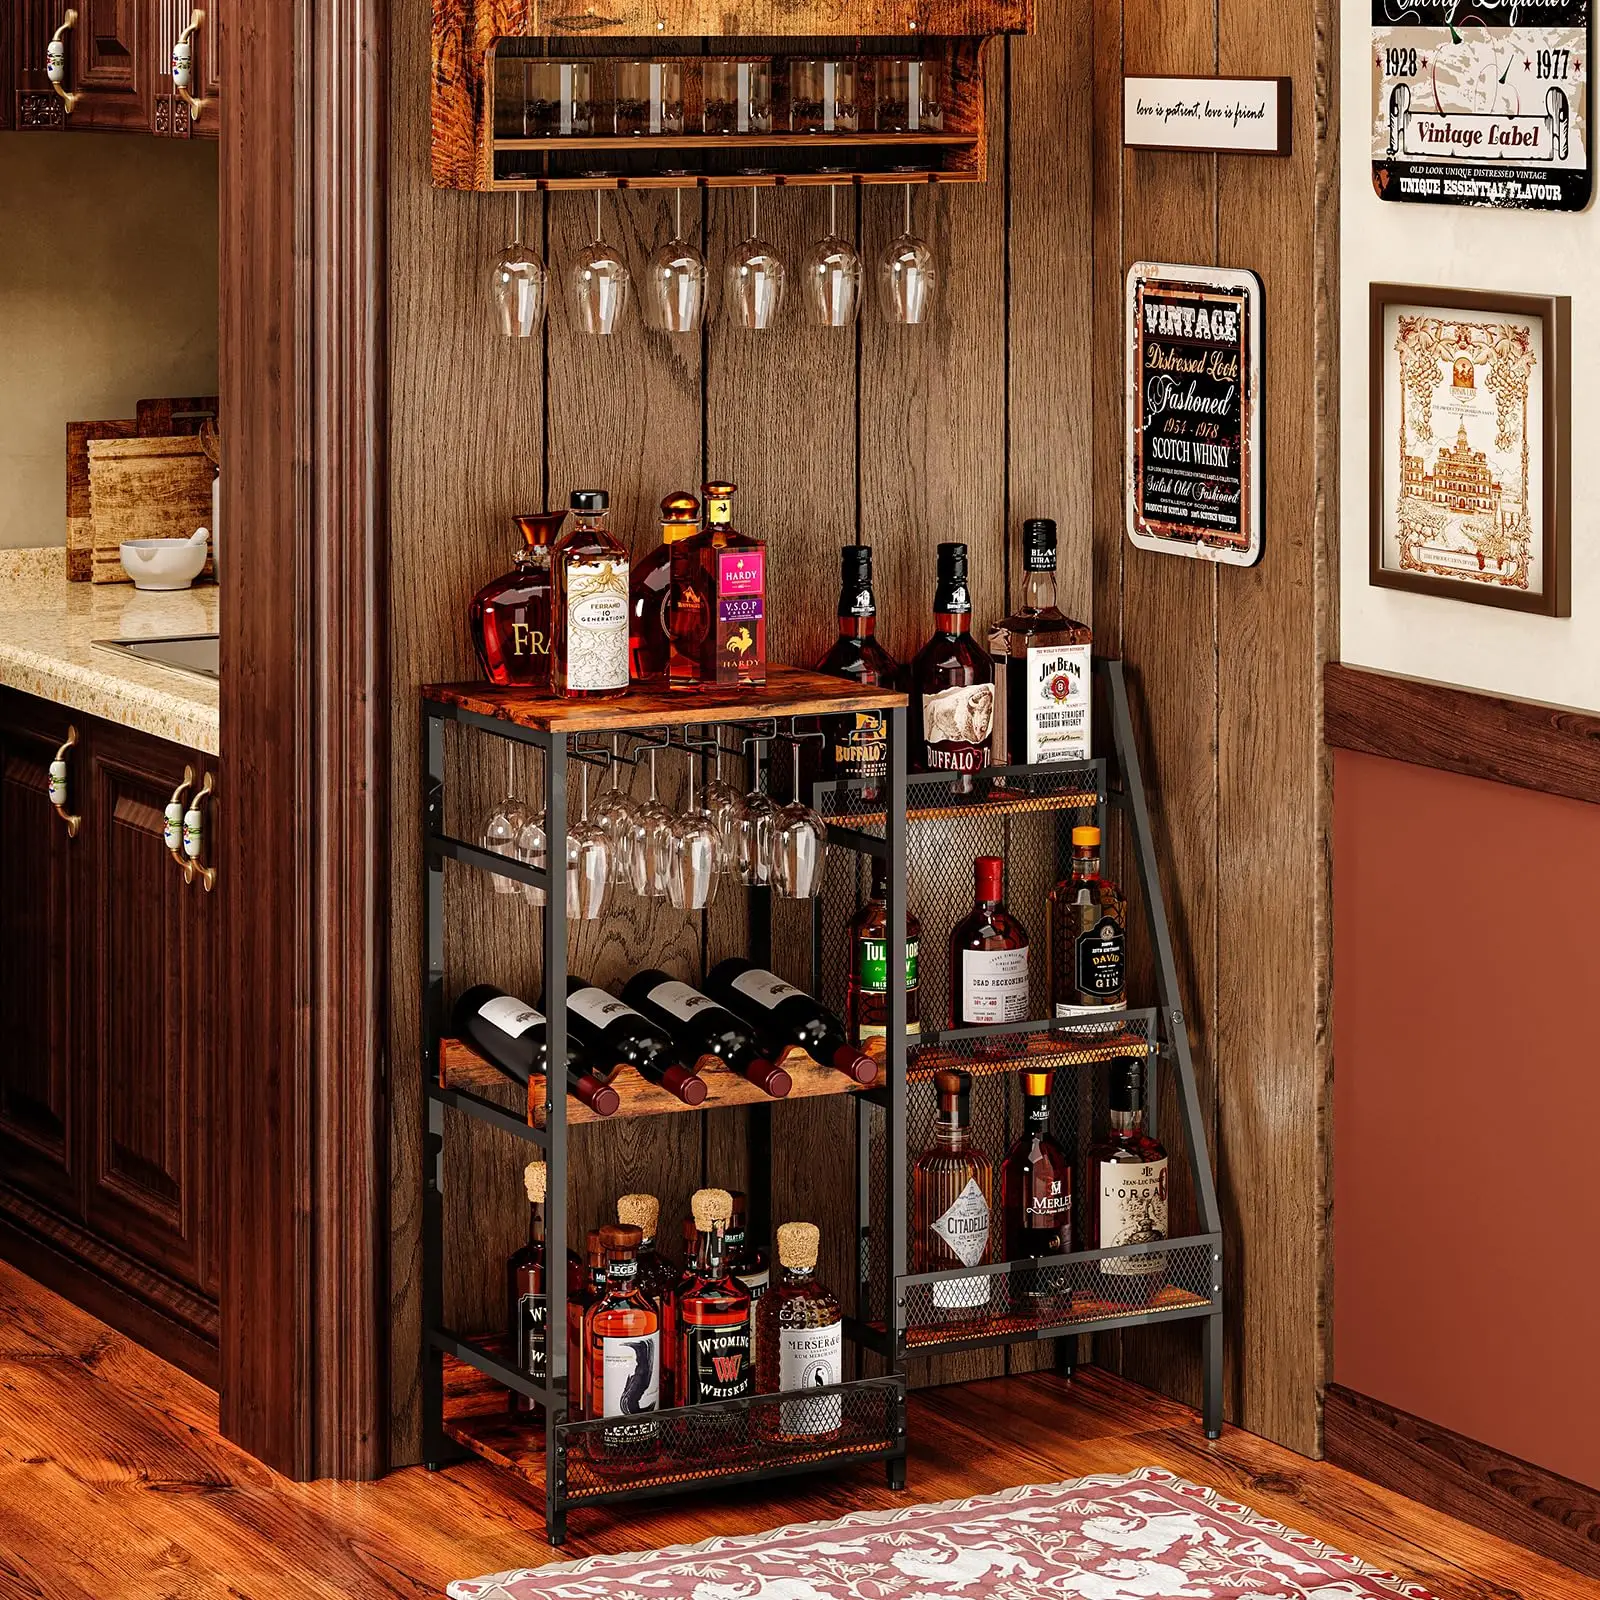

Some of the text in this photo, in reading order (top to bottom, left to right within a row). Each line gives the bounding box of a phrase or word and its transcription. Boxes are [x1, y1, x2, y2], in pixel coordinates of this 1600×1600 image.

[1385, 47, 1417, 77] 1928
[1536, 49, 1570, 80] 1977
[1136, 98, 1265, 128] love is patient, love is friend
[1417, 121, 1540, 147] Vintage Label
[1409, 165, 1547, 180] OLD LOOK UNIQUE DISTRESSED VINTAGE
[1400, 177, 1562, 201] UNIQUE ESSENTIAL FLAVOUR
[1145, 303, 1237, 342] VINTAGE
[1145, 342, 1238, 383] Distressed Look
[1147, 374, 1235, 416] Fashoned
[1195, 421, 1220, 438] 1978
[1152, 436, 1230, 468] SCOTCH WHISKY
[1173, 479, 1193, 497] Old
[1192, 482, 1241, 504] Fashioned
[1194, 503, 1220, 511] SCOTLAND
[725, 570, 757, 582] HARDY
[590, 602, 621, 610] FERRAND
[723, 659, 760, 669] HARDY
[1039, 656, 1081, 683] JIM BEAM
[1036, 709, 1085, 721] KENTUCKY STRAIGHT
[1039, 718, 1082, 729] BOURBON WHISKEY
[835, 744, 881, 762] BUFFALO
[927, 744, 973, 771] BUFFALO
[1092, 953, 1120, 965] DAVID
[973, 979, 990, 987] DEAD
[1095, 977, 1119, 988] GIN
[1122, 1178, 1148, 1187] JEAN-LUC
[1033, 1194, 1072, 1209] MERLET
[947, 1214, 988, 1234] CITADELLE
[698, 1335, 749, 1355] WYOMING
[699, 1378, 749, 1398] WHISKEY
